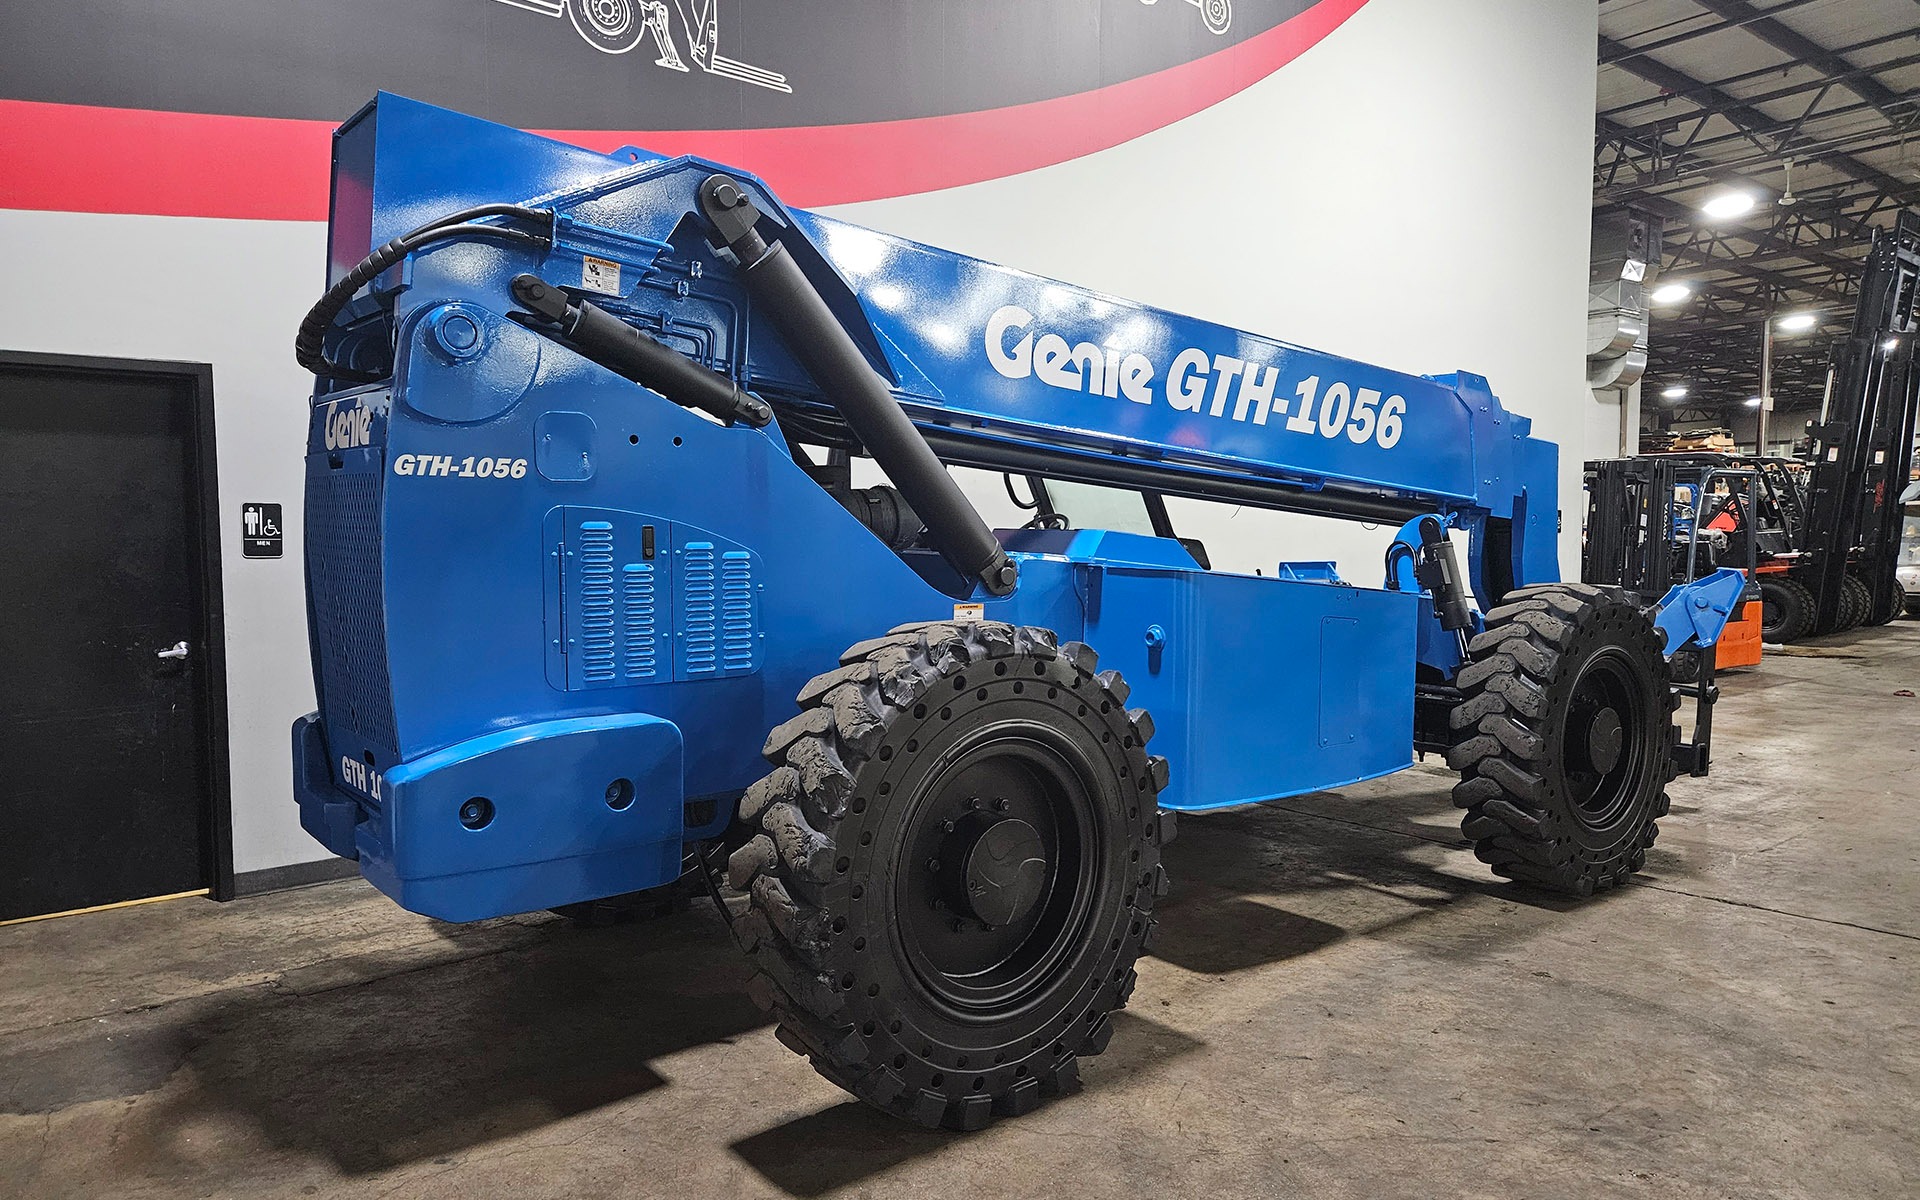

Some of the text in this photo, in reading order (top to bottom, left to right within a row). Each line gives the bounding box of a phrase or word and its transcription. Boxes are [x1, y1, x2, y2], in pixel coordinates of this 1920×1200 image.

[984, 305, 1407, 450] Genie GTH-1056
[325, 397, 370, 450] Genie
[393, 454, 528, 479] GTH-1056
[342, 755, 367, 793] GTH
